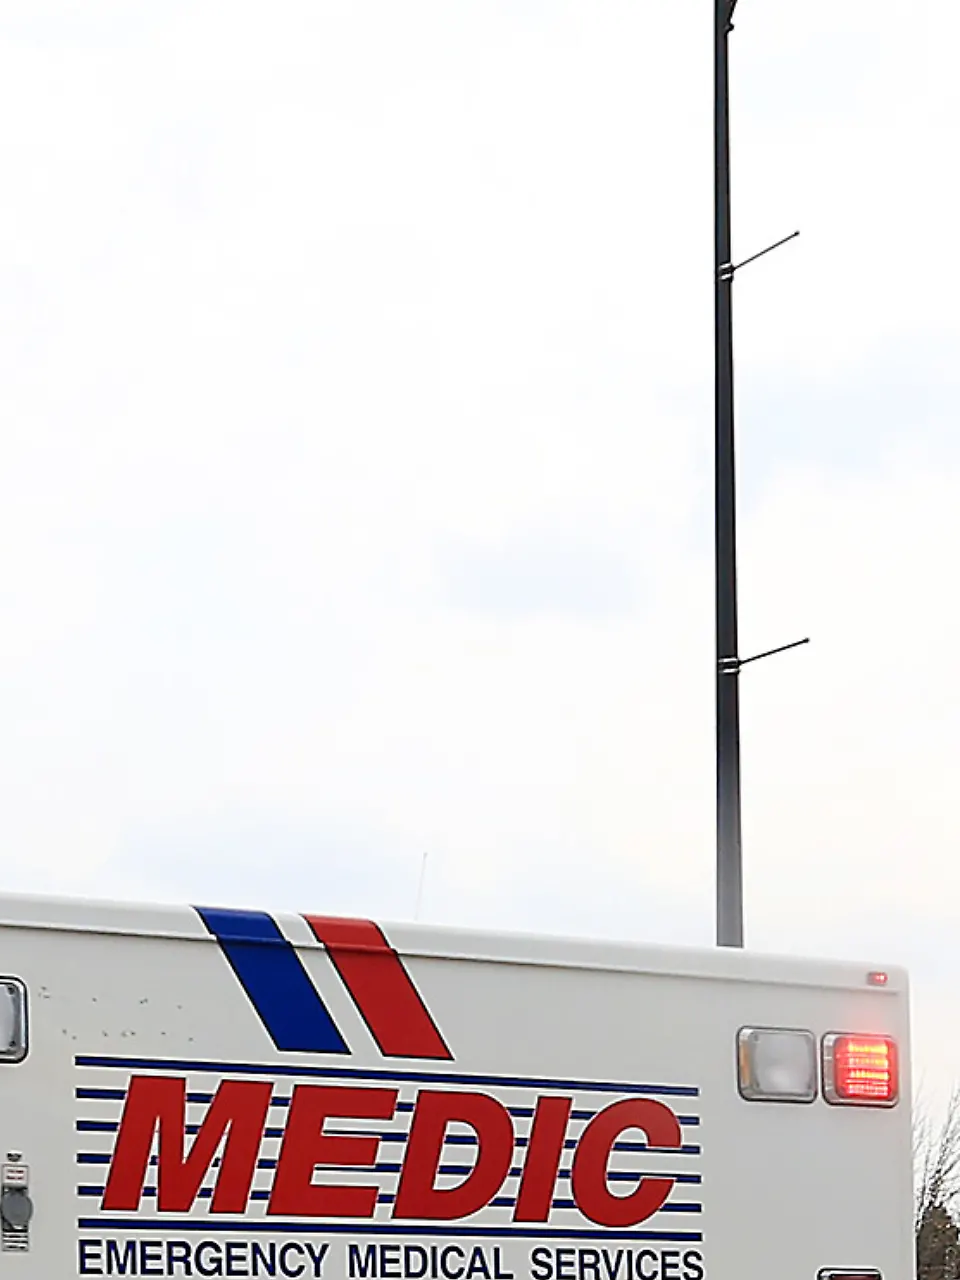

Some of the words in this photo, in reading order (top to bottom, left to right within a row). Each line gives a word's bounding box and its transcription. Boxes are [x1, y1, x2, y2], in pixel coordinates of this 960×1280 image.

[100, 1074, 682, 1228] MEDIC
[78, 1239, 330, 1279] EMERGENCY
[348, 1244, 515, 1280] MEDICAL
